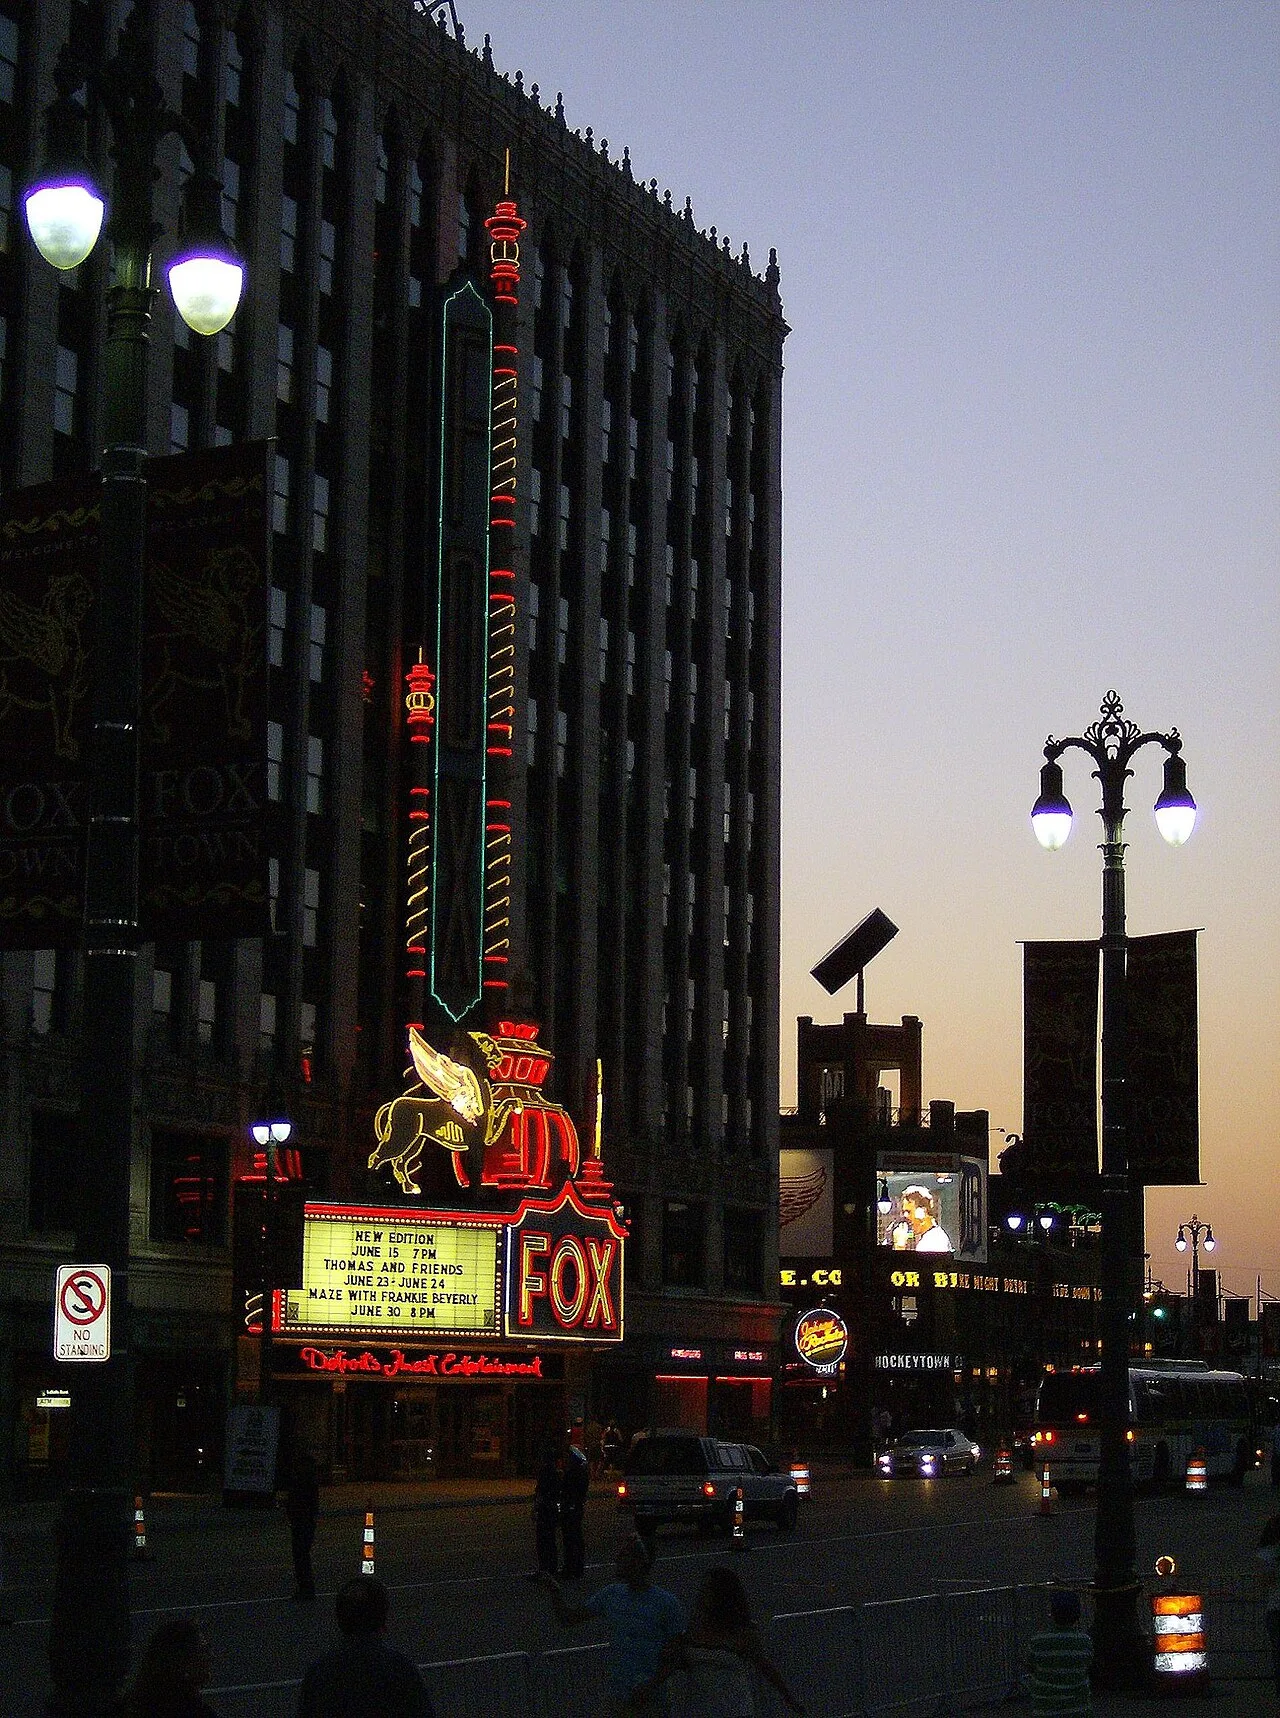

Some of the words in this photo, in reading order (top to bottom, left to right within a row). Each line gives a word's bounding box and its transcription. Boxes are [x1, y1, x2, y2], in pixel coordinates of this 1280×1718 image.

[150, 761, 261, 818] FOX
[148, 829, 260, 868] TOWN
[356, 1231, 382, 1242] NEW
[389, 1233, 433, 1244] EDITION
[352, 1246, 380, 1257] JUNE
[388, 1248, 399, 1259] 15
[324, 1259, 373, 1271] THOMAS
[381, 1262, 404, 1272] AND
[412, 1263, 463, 1275] FRIENDS
[346, 1275, 373, 1286] JUNE
[377, 1277, 388, 1286] 23
[399, 1278, 427, 1288] JUNE
[431, 1279, 444, 1288] 24
[519, 1230, 617, 1329] FOX
[890, 1271, 920, 1287] OR
[309, 1289, 342, 1300] MAZE
[349, 1290, 376, 1301] WITH
[382, 1292, 427, 1303] FRANKIE
[351, 1305, 381, 1316] JUNE
[388, 1307, 400, 1316] 30
[73, 1330, 91, 1341] NO
[60, 1344, 105, 1356] STANDING
[875, 1355, 950, 1368] HOCKEYTOWN
